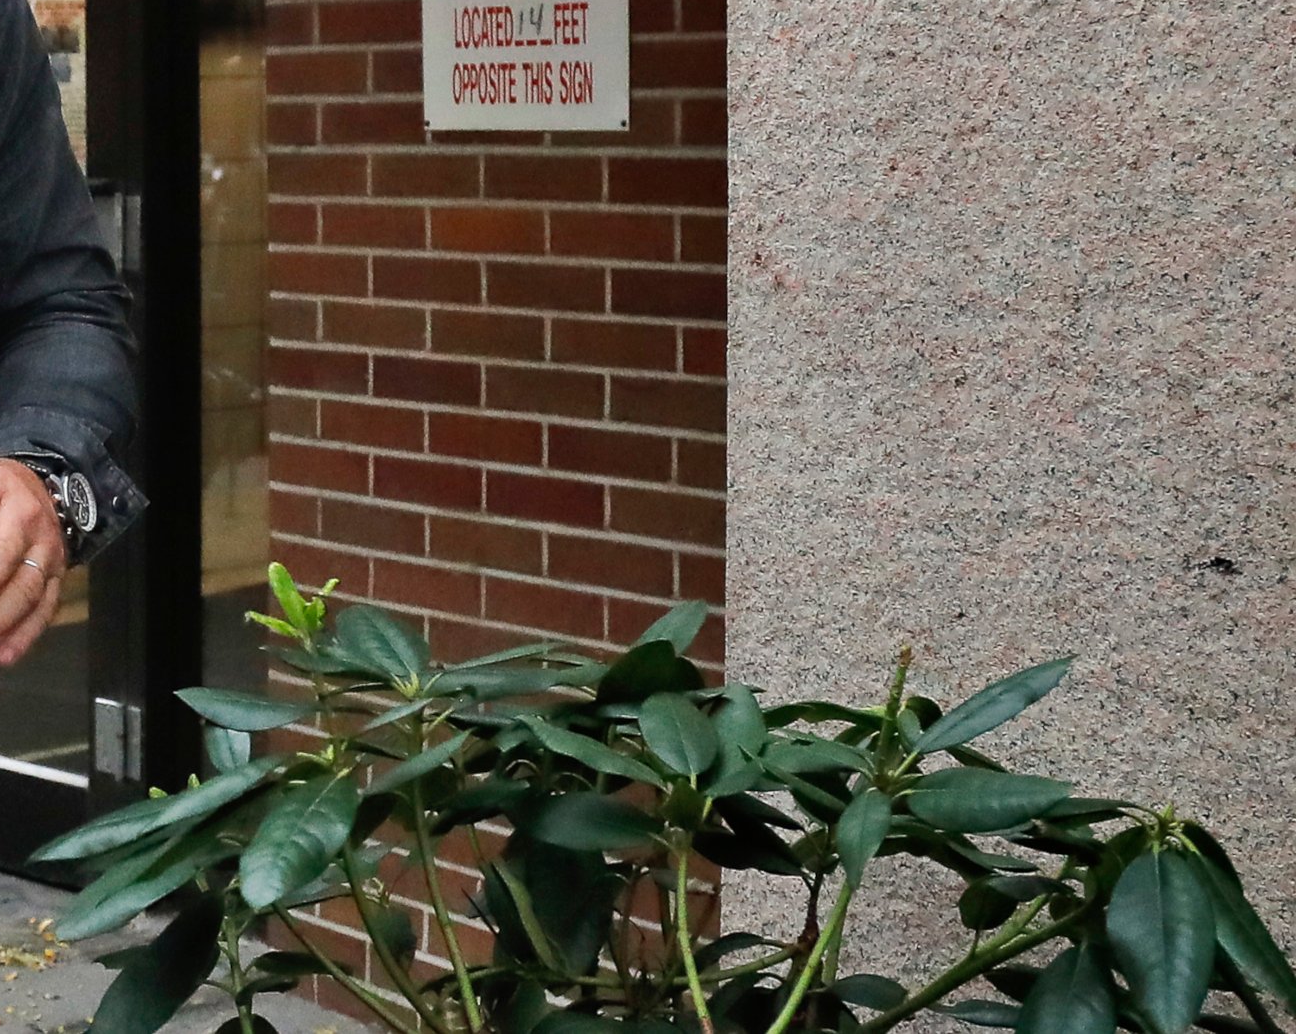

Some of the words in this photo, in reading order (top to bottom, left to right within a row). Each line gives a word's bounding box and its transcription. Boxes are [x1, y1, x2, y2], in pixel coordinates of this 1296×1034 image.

[454, 5, 514, 49] LOCATED
[554, 1, 589, 45] FEET
[453, 61, 517, 104] OPPOSITE
[522, 61, 553, 104] THIS
[559, 60, 594, 104] SIGN
